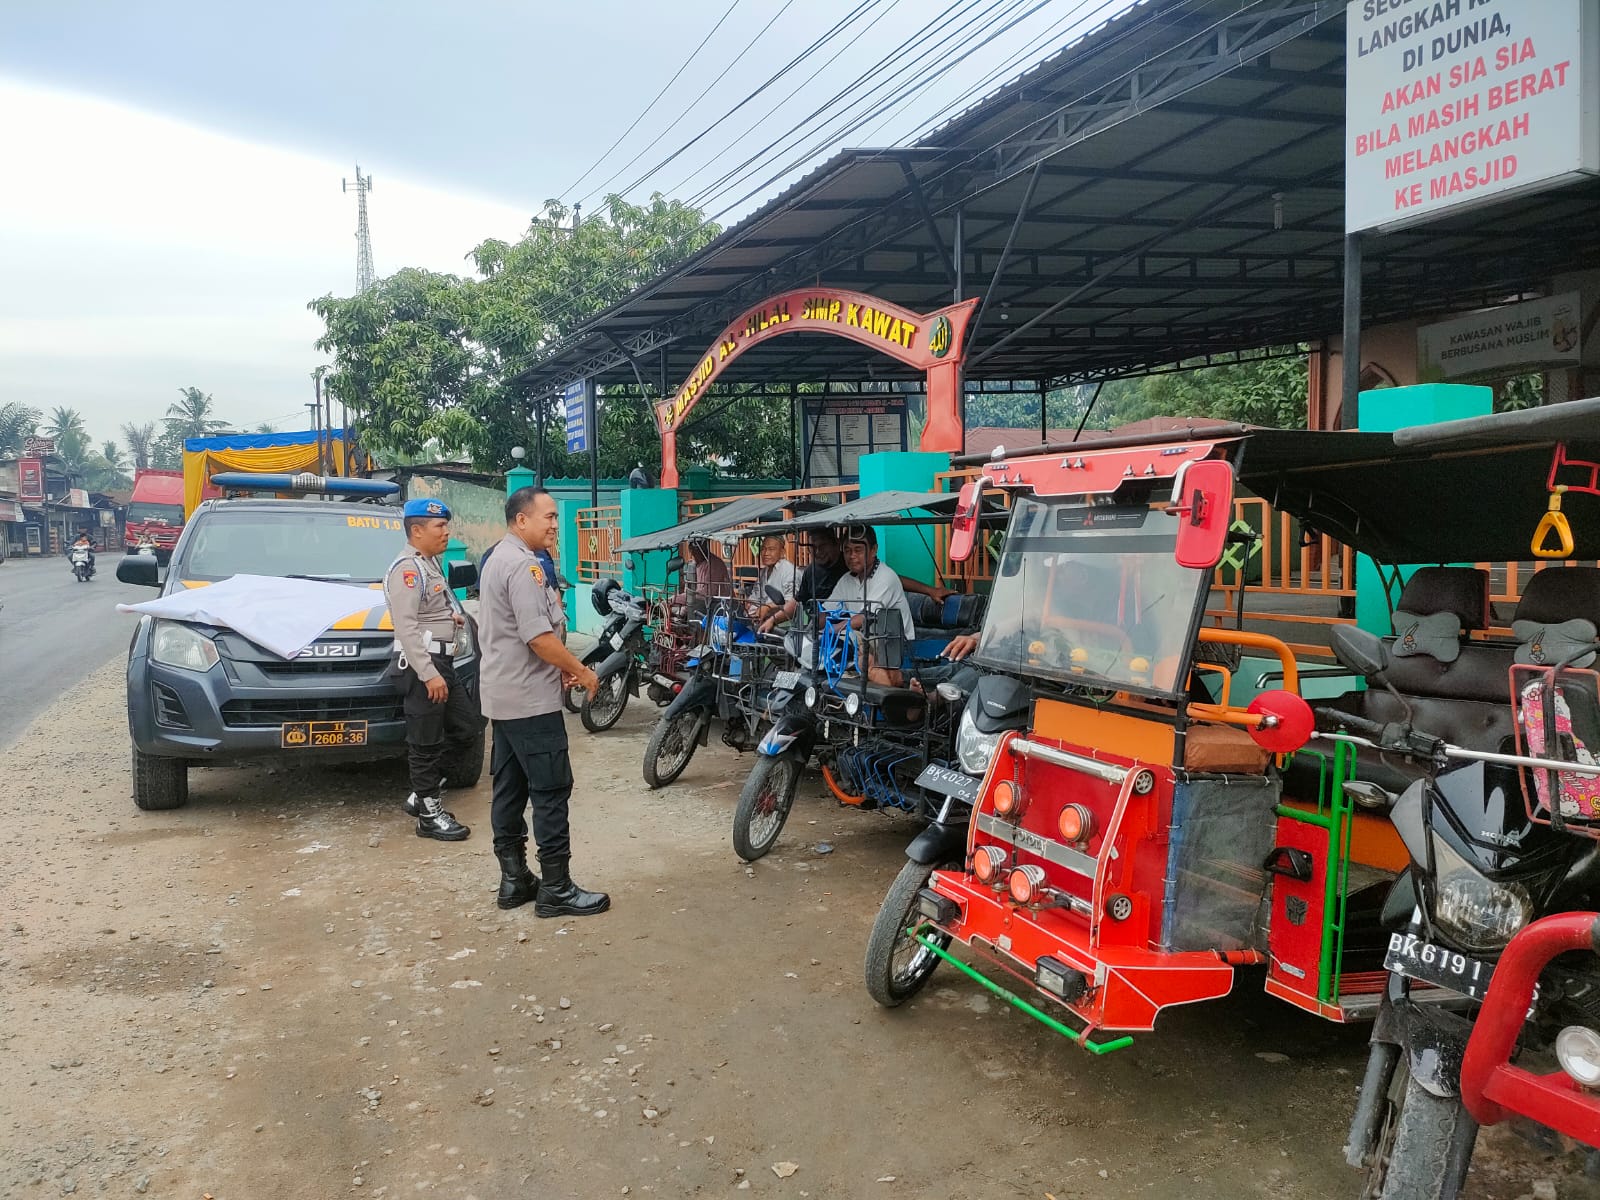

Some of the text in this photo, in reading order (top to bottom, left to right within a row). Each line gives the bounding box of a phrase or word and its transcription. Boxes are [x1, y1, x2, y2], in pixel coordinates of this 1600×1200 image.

[1358, 0, 1460, 58] LANGKAH
[1403, 12, 1511, 72] DI DUNIA,
[1381, 37, 1536, 115] AKAN SIA SIA
[1355, 61, 1570, 156] BILA MASIH BERAT
[1385, 113, 1529, 179] MELANGKAH
[1395, 155, 1517, 210] KE MASJID
[1441, 340, 1503, 360] BERBUSANA
[1507, 330, 1549, 346] MUSLIM
[1450, 316, 1541, 344] KAWASAN WAJIB
[676, 355, 714, 416] MASJID
[846, 303, 916, 349] KAWAT
[347, 516, 379, 528] BATU
[300, 645, 357, 656] SUZU
[315, 733, 363, 745] 2608-36
